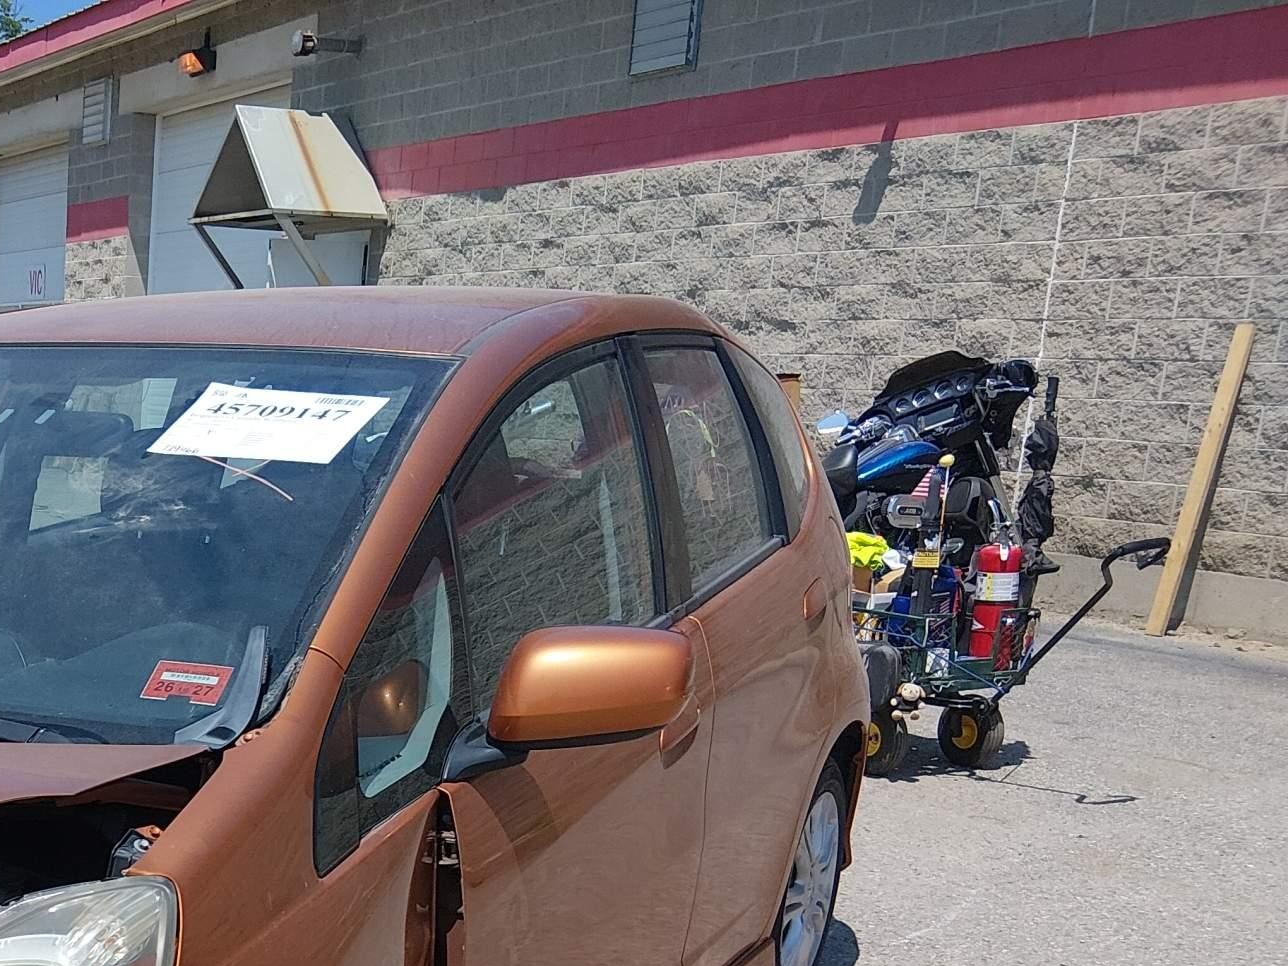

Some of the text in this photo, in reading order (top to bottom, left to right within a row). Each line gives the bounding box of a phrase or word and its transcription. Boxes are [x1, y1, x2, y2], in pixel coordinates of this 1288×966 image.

[207, 402, 353, 421] 45709147
[153, 681, 176, 693] 26
[192, 685, 215, 697] 27
